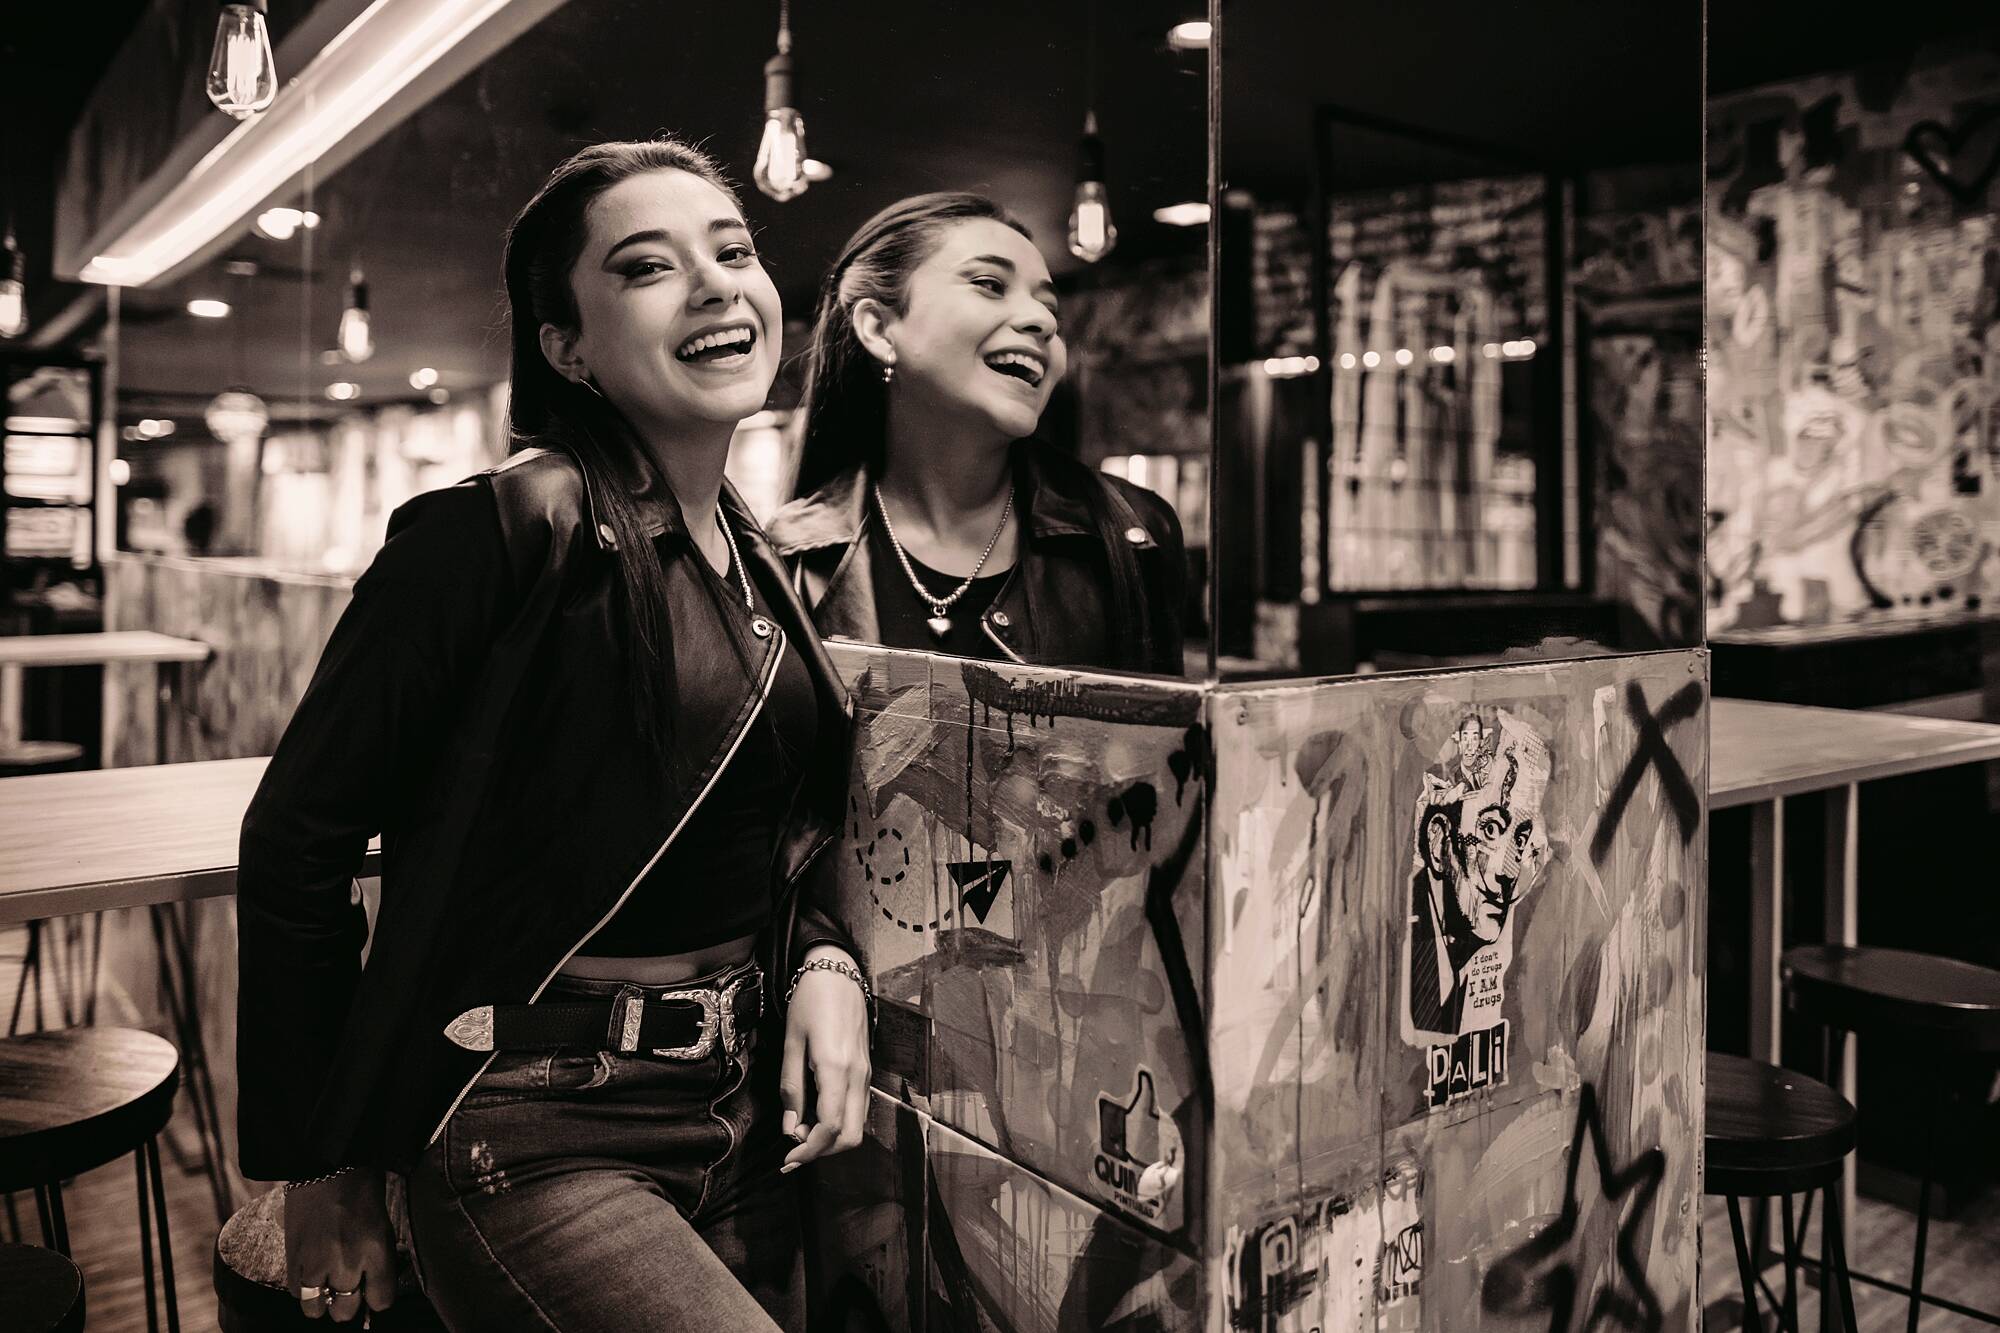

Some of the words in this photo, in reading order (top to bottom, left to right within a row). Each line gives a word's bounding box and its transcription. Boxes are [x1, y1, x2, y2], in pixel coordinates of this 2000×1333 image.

[1474, 956, 1478, 965] I
[1480, 952, 1498, 963] don't
[1472, 968, 1480, 976] do
[1482, 963, 1502, 973] drugs
[1469, 981, 1475, 997] I
[1480, 976, 1497, 993] AM
[1473, 994, 1501, 1008] drugs
